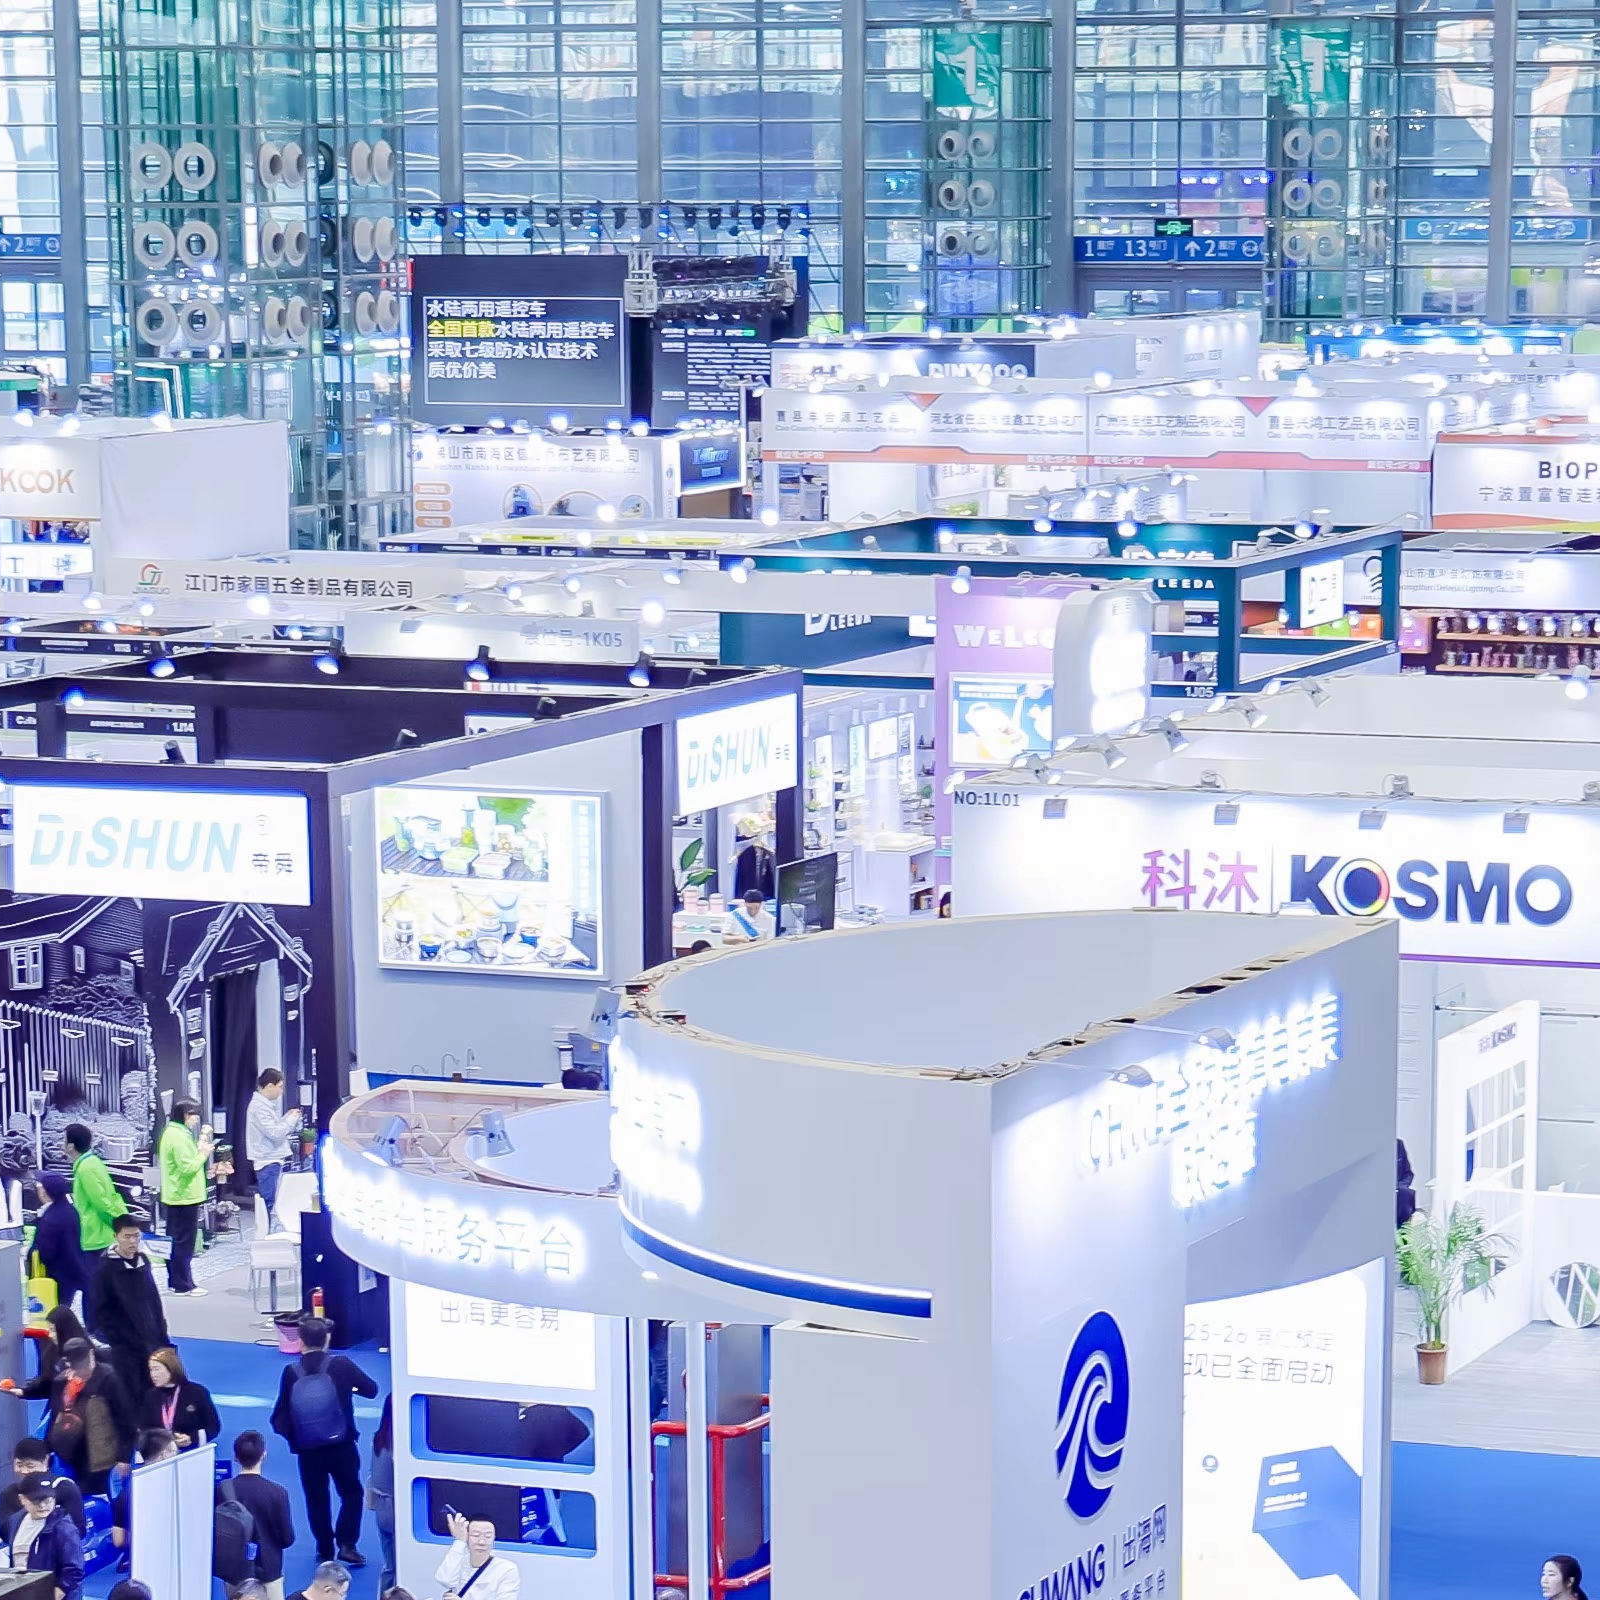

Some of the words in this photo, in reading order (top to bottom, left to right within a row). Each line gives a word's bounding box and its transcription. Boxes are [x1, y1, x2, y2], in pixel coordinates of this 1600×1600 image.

[955, 45, 977, 95] 1
[14, 237, 25, 252] 2
[1084, 240, 1095, 257] 1
[1124, 240, 1148, 257] 13
[1204, 240, 1217, 257] 2
[427, 300, 547, 318] 水陆两用遥控车
[427, 321, 615, 339] 全国首款水陆两用遥控车
[427, 342, 598, 359] 采取七级防水认证技术
[427, 362, 497, 379] 质优价美
[185, 573, 414, 598] 江门市家国五金制品有限公司
[1141, 847, 1258, 913] 科沐
[1290, 854, 1573, 927] KOSMO
[1121, 1502, 1168, 1569] 出海网
